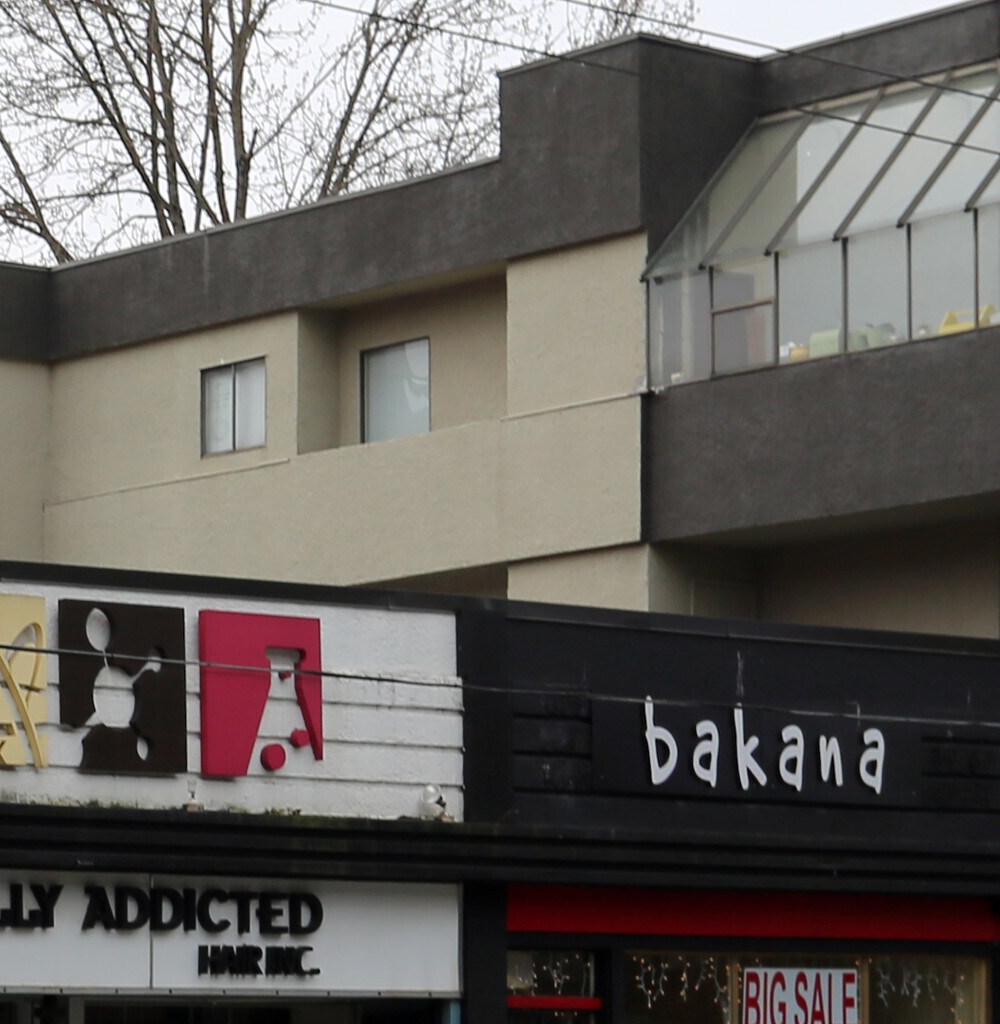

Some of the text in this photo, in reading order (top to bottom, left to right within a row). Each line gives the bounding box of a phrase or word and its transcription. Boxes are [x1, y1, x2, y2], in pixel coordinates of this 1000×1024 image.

[645, 695, 886, 794] bakana
[81, 886, 324, 935] ADDICTED
[198, 945, 263, 976] HAIR
